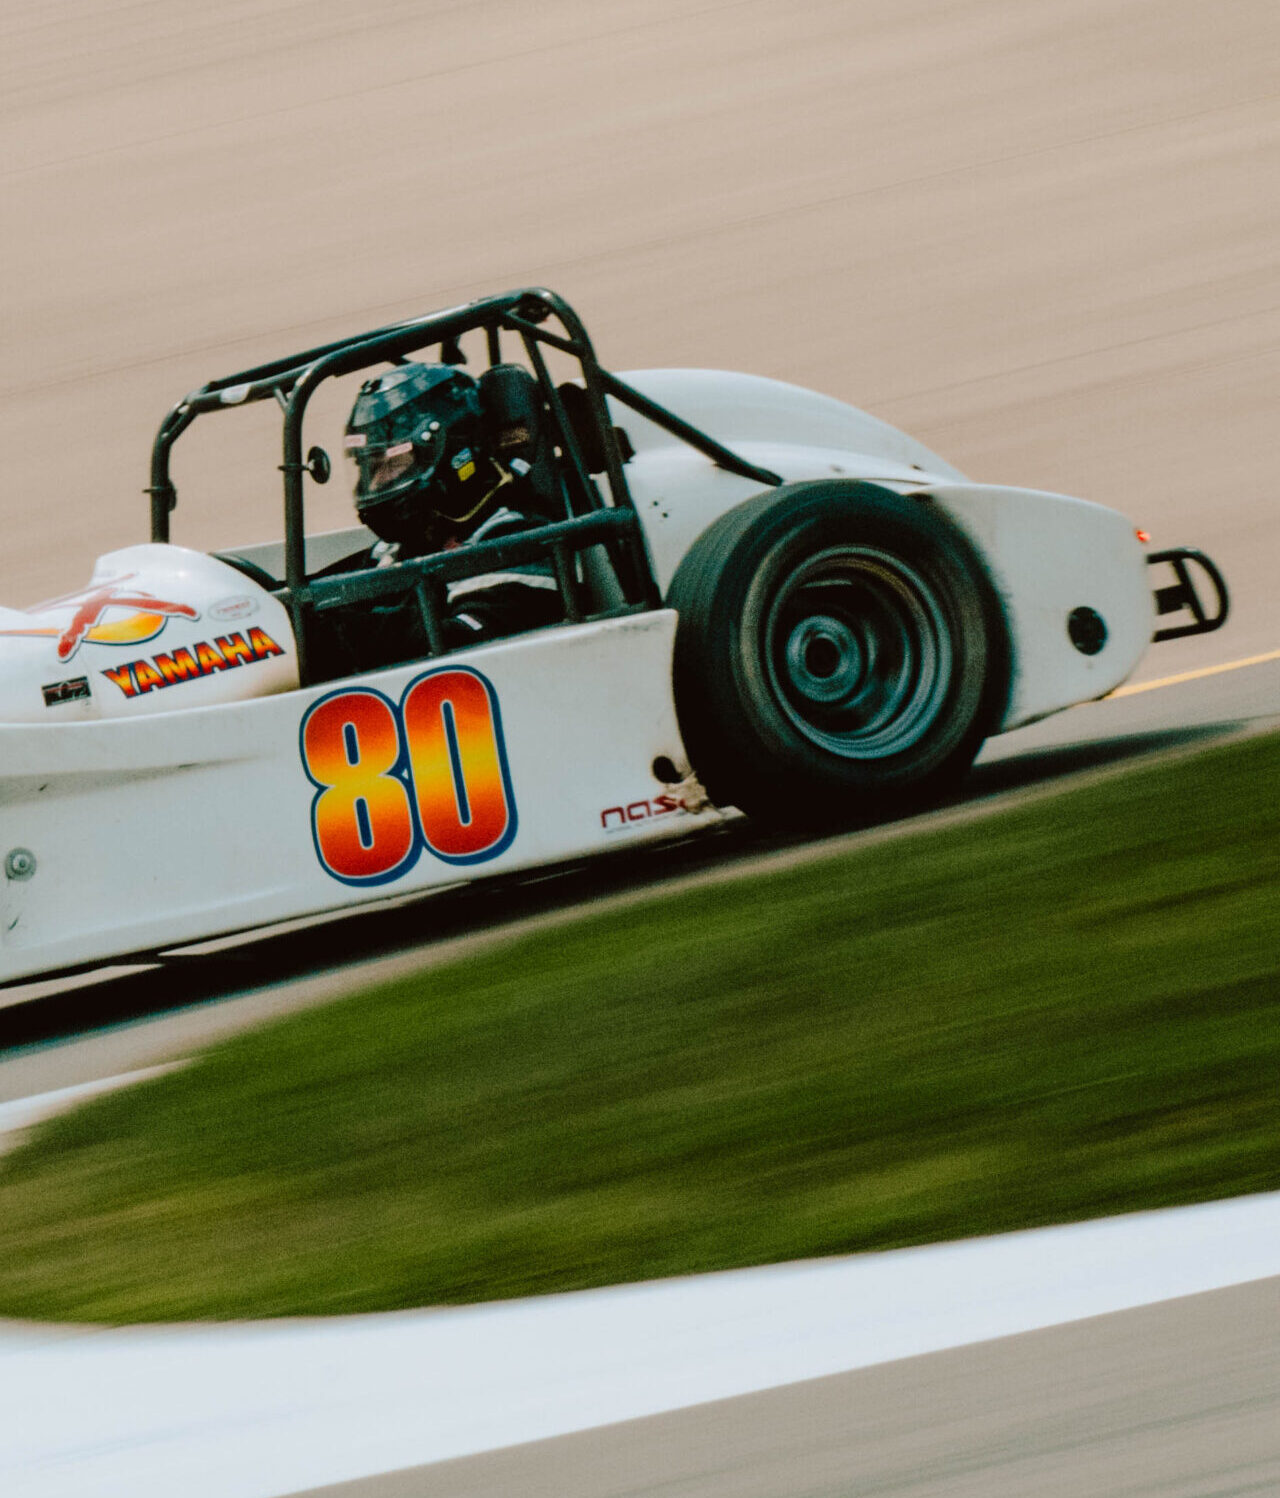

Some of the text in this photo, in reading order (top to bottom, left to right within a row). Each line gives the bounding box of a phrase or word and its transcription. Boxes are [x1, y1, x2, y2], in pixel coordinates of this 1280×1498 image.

[100, 626, 285, 698] YAMAHA
[299, 664, 518, 887] 80
[600, 794, 688, 828] nas
